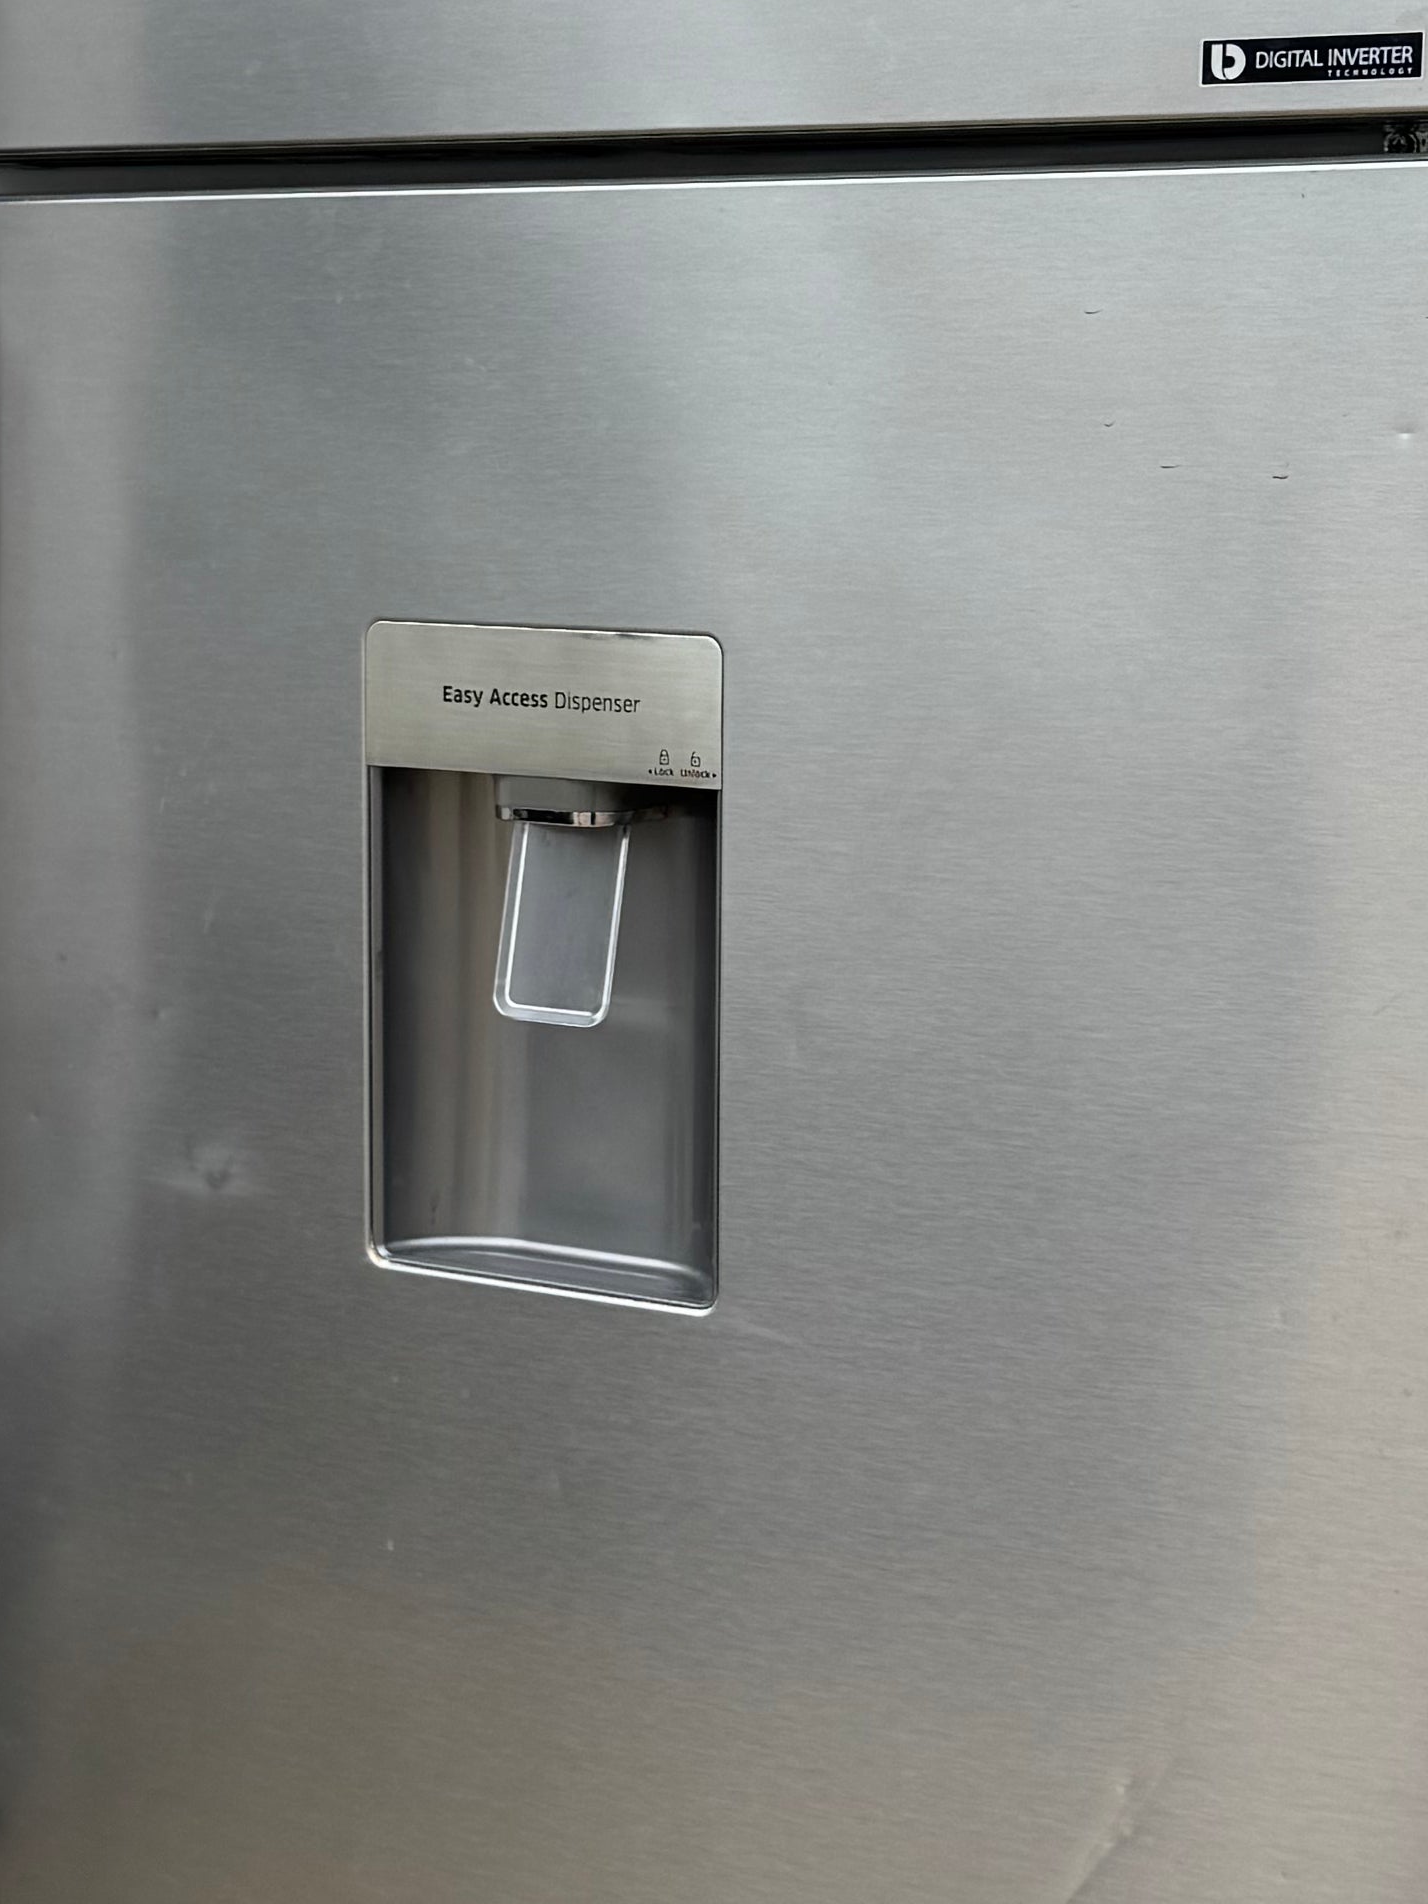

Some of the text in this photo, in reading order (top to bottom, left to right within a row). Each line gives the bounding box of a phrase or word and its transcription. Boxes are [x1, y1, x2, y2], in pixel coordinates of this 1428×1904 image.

[1255, 46, 1413, 69] DIGITAL INVERTER
[1327, 67, 1413, 77] TECHNOLOGY
[442, 685, 640, 713] Easy Access Dispenser
